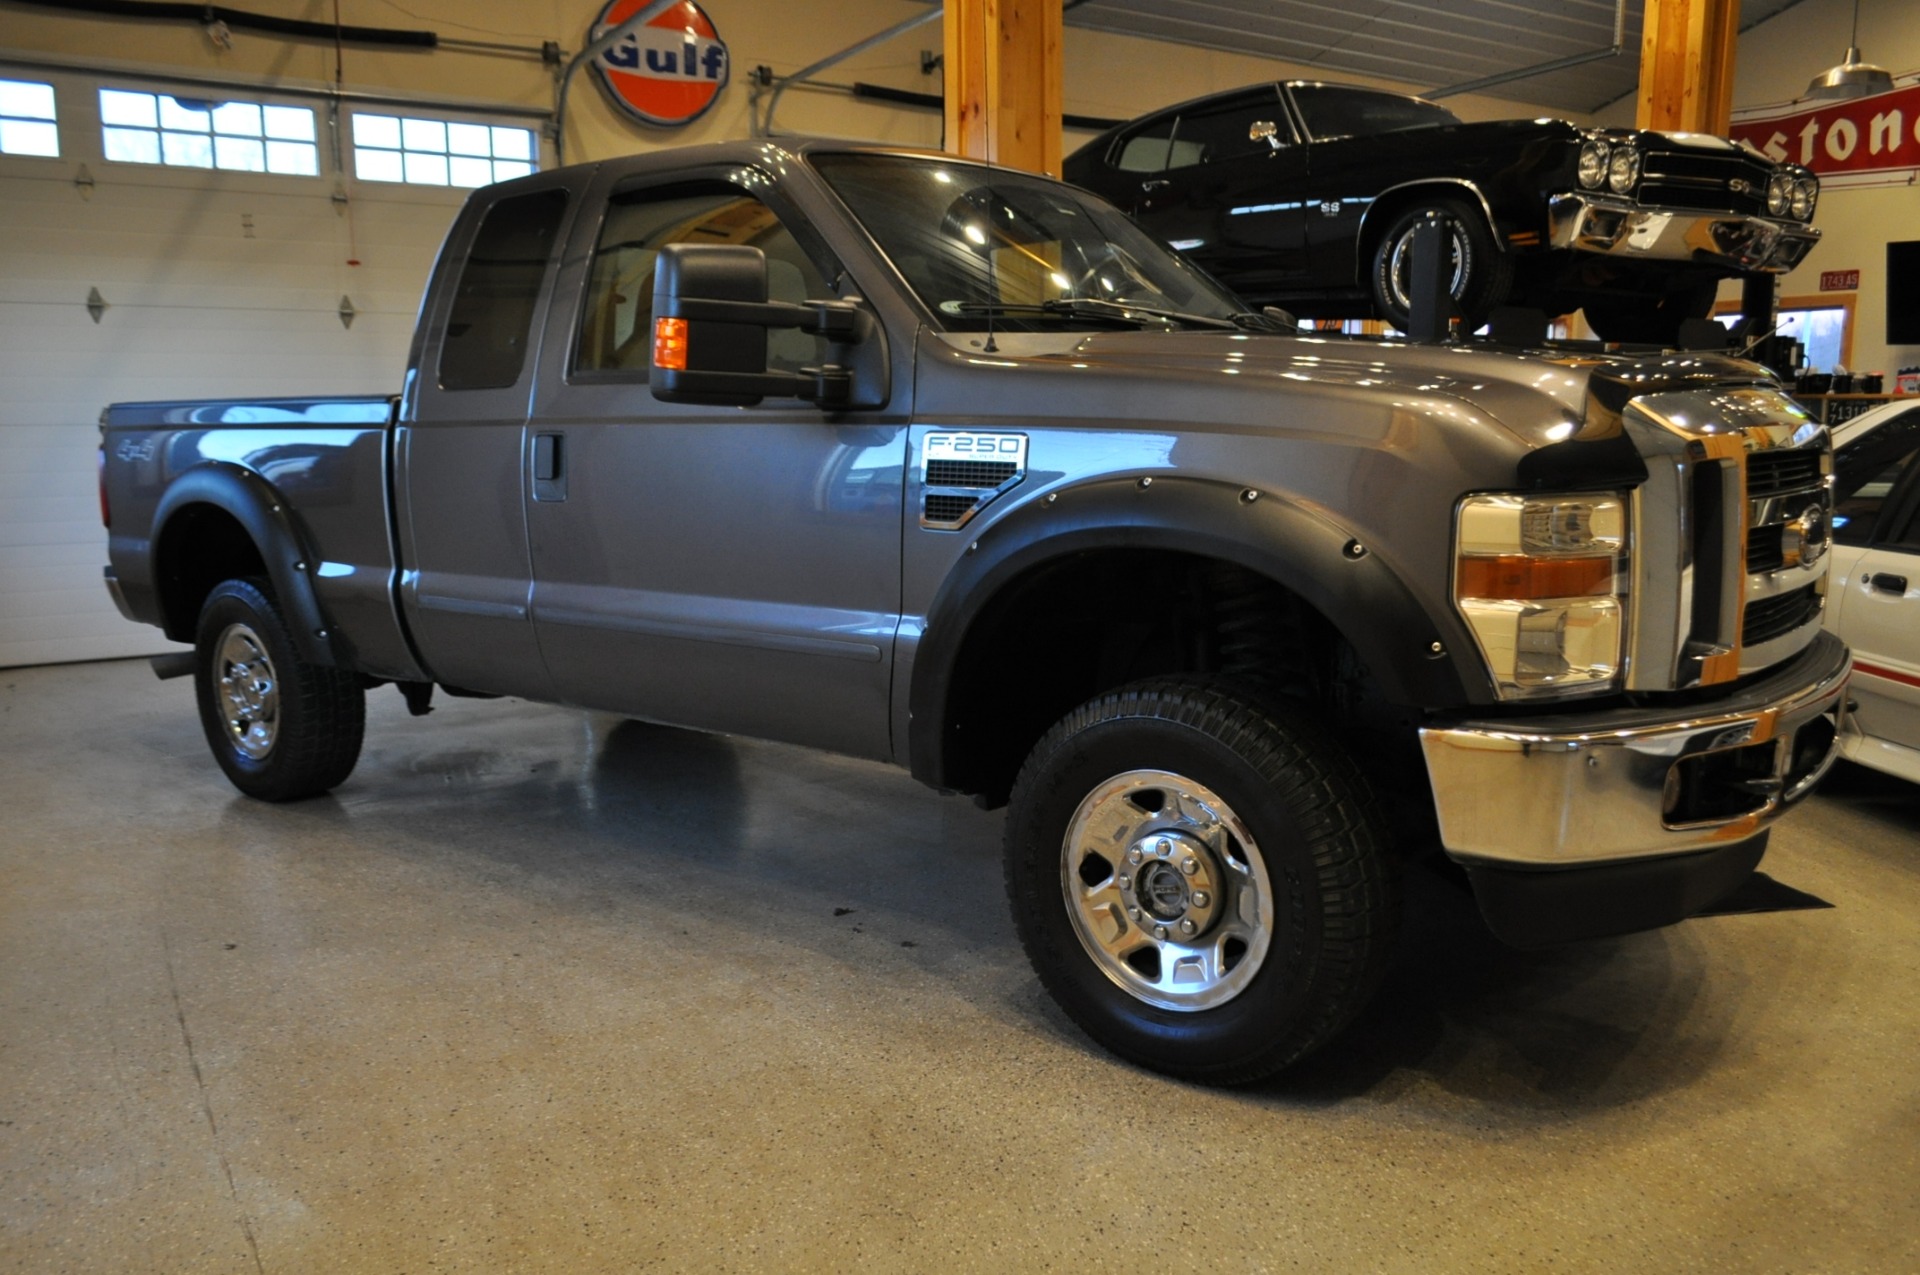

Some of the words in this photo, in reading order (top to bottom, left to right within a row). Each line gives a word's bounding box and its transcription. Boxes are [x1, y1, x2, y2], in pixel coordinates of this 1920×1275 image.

[602, 33, 723, 79] Gulf
[1729, 178, 1750, 194] SS
[1320, 201, 1339, 212] SS
